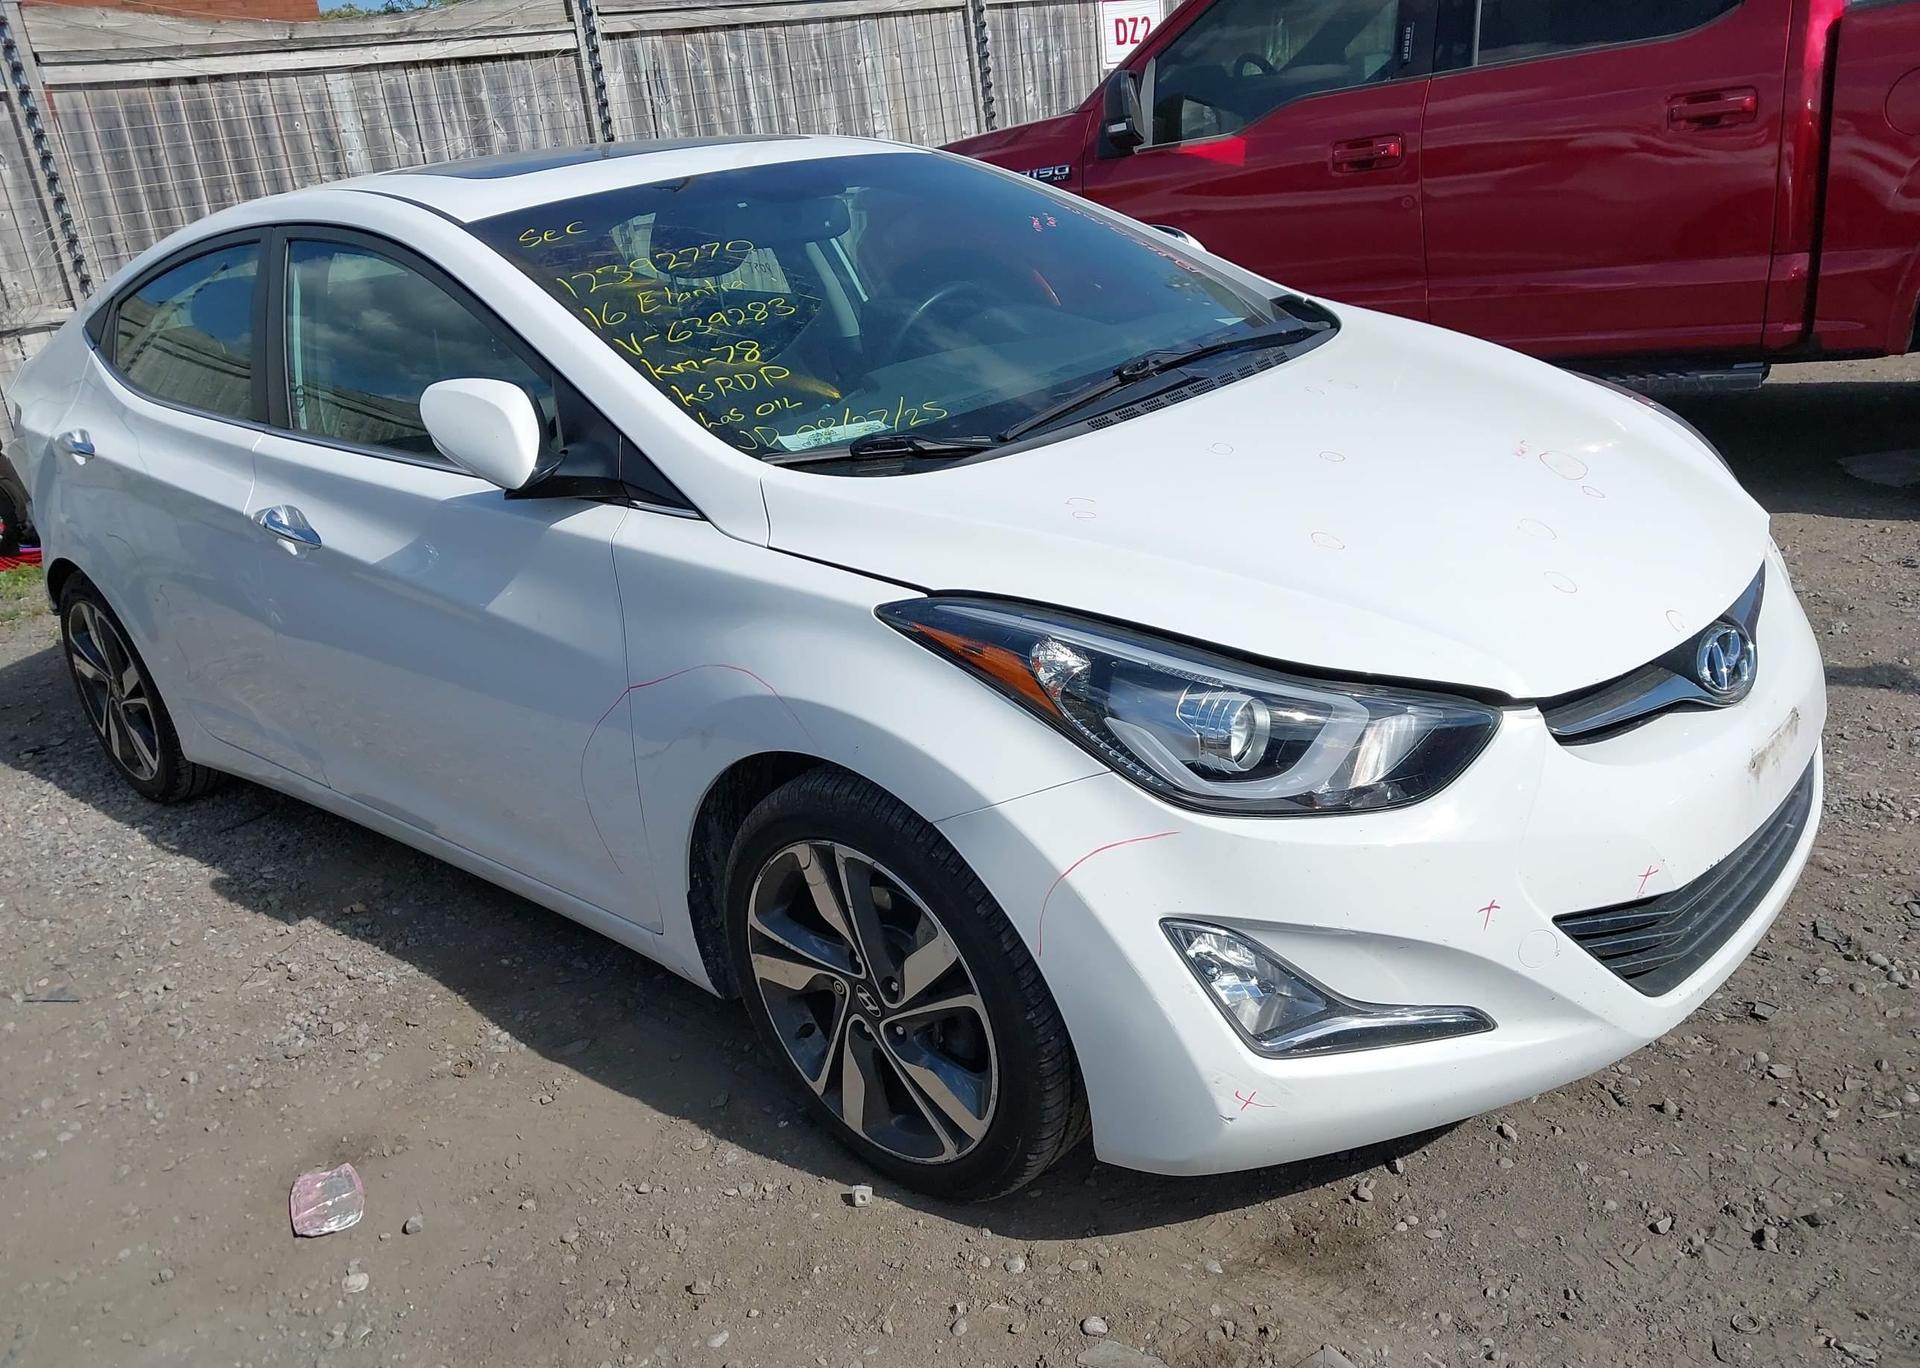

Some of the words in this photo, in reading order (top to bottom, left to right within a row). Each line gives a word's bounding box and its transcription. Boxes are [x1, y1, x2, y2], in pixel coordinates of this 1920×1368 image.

[1115, 16, 1151, 46] DZ2
[1018, 164, 1070, 179] 150
[556, 239, 754, 299] 12392770
[583, 301, 627, 330] 16
[636, 278, 746, 314] Elantra
[736, 425, 780, 451] JD
